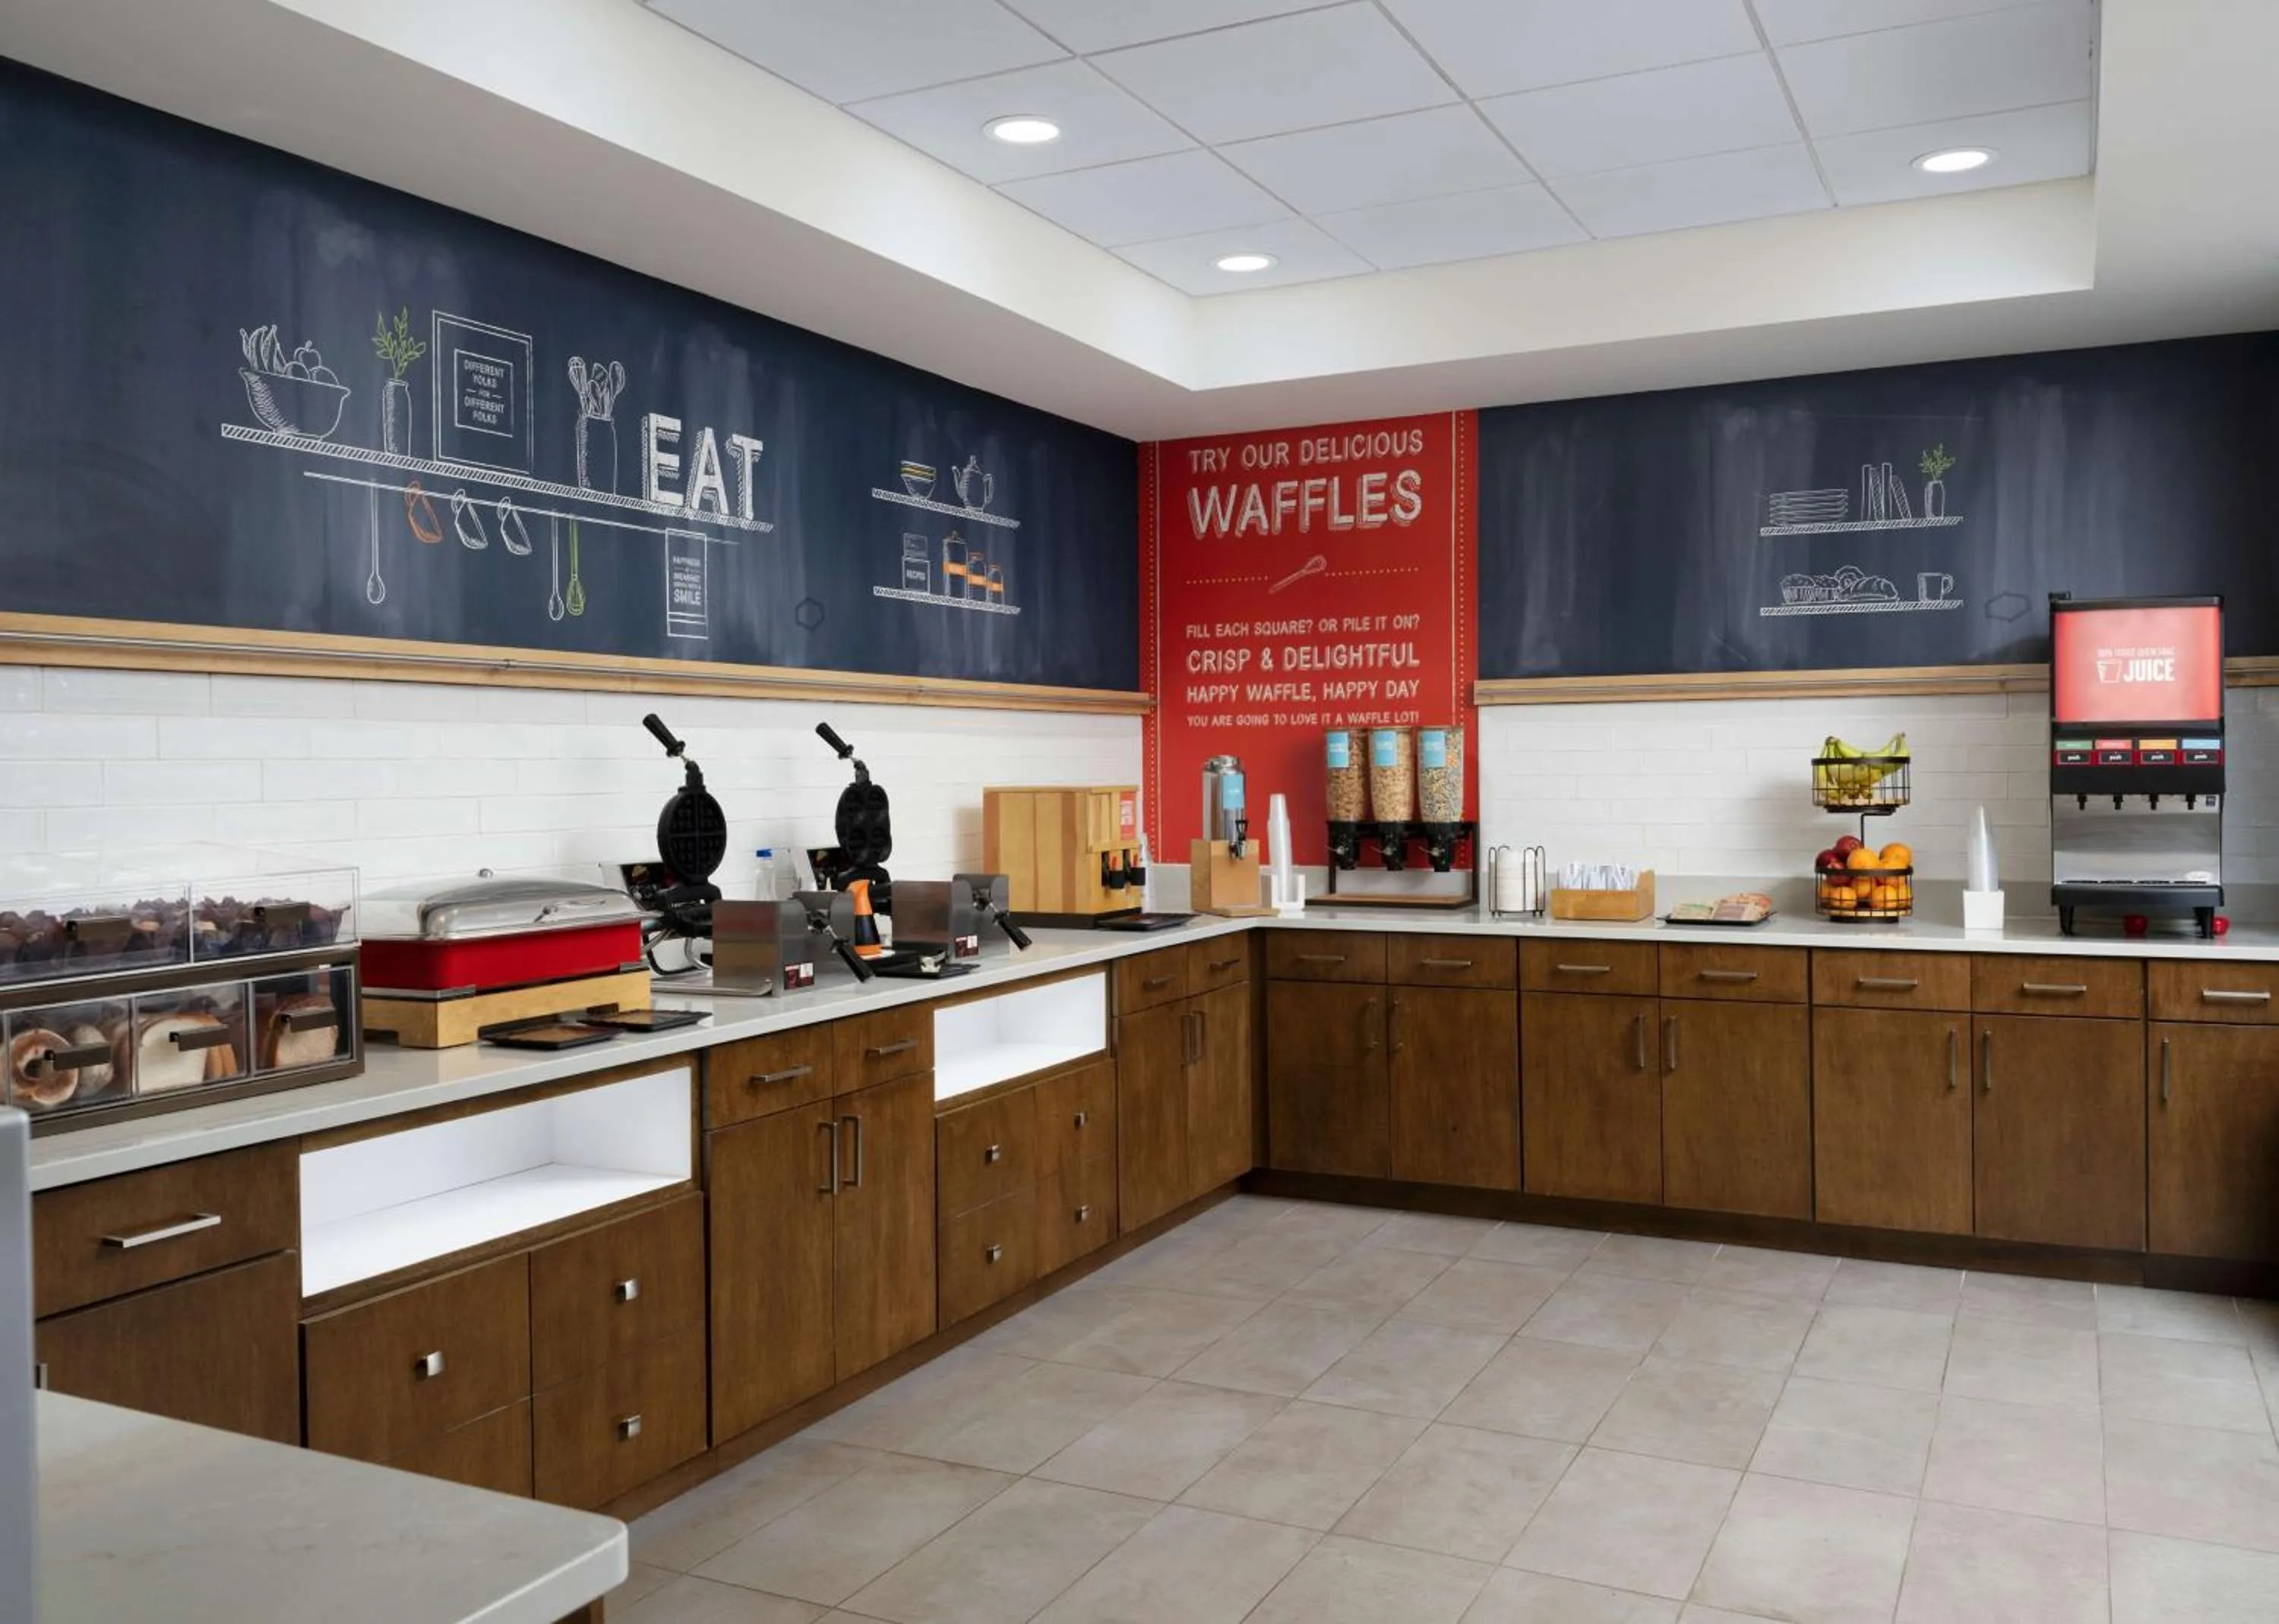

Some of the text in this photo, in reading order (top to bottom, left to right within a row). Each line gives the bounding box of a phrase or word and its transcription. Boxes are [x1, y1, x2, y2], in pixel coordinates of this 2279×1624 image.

[464, 359, 504, 378] DIFFERENT
[464, 396, 504, 414] DIFFERENT
[1190, 429, 1423, 474] TRY OUR DELICIOUS
[641, 412, 763, 520] EAT
[1187, 469, 1422, 540] WAFFLES
[674, 589, 701, 605] SMILE
[1186, 614, 1420, 638] FILL EACH SQUARE? OR PILE IT ON?
[1187, 642, 1421, 674] CRISP & DELIGHTFUL
[2123, 659, 2176, 682] JUICE
[1187, 680, 1421, 703] HAPPY WAFFLE, HAPPY DAY
[1187, 715, 1209, 727] YOU
[1211, 715, 1234, 726] ARE
[1236, 713, 1269, 725] GOING
[1273, 713, 1287, 725] TO
[1291, 712, 1317, 725] LOVE
[1321, 712, 1331, 725] IT
[1335, 712, 1342, 724] A
[1347, 712, 1390, 724] WAFFLE
